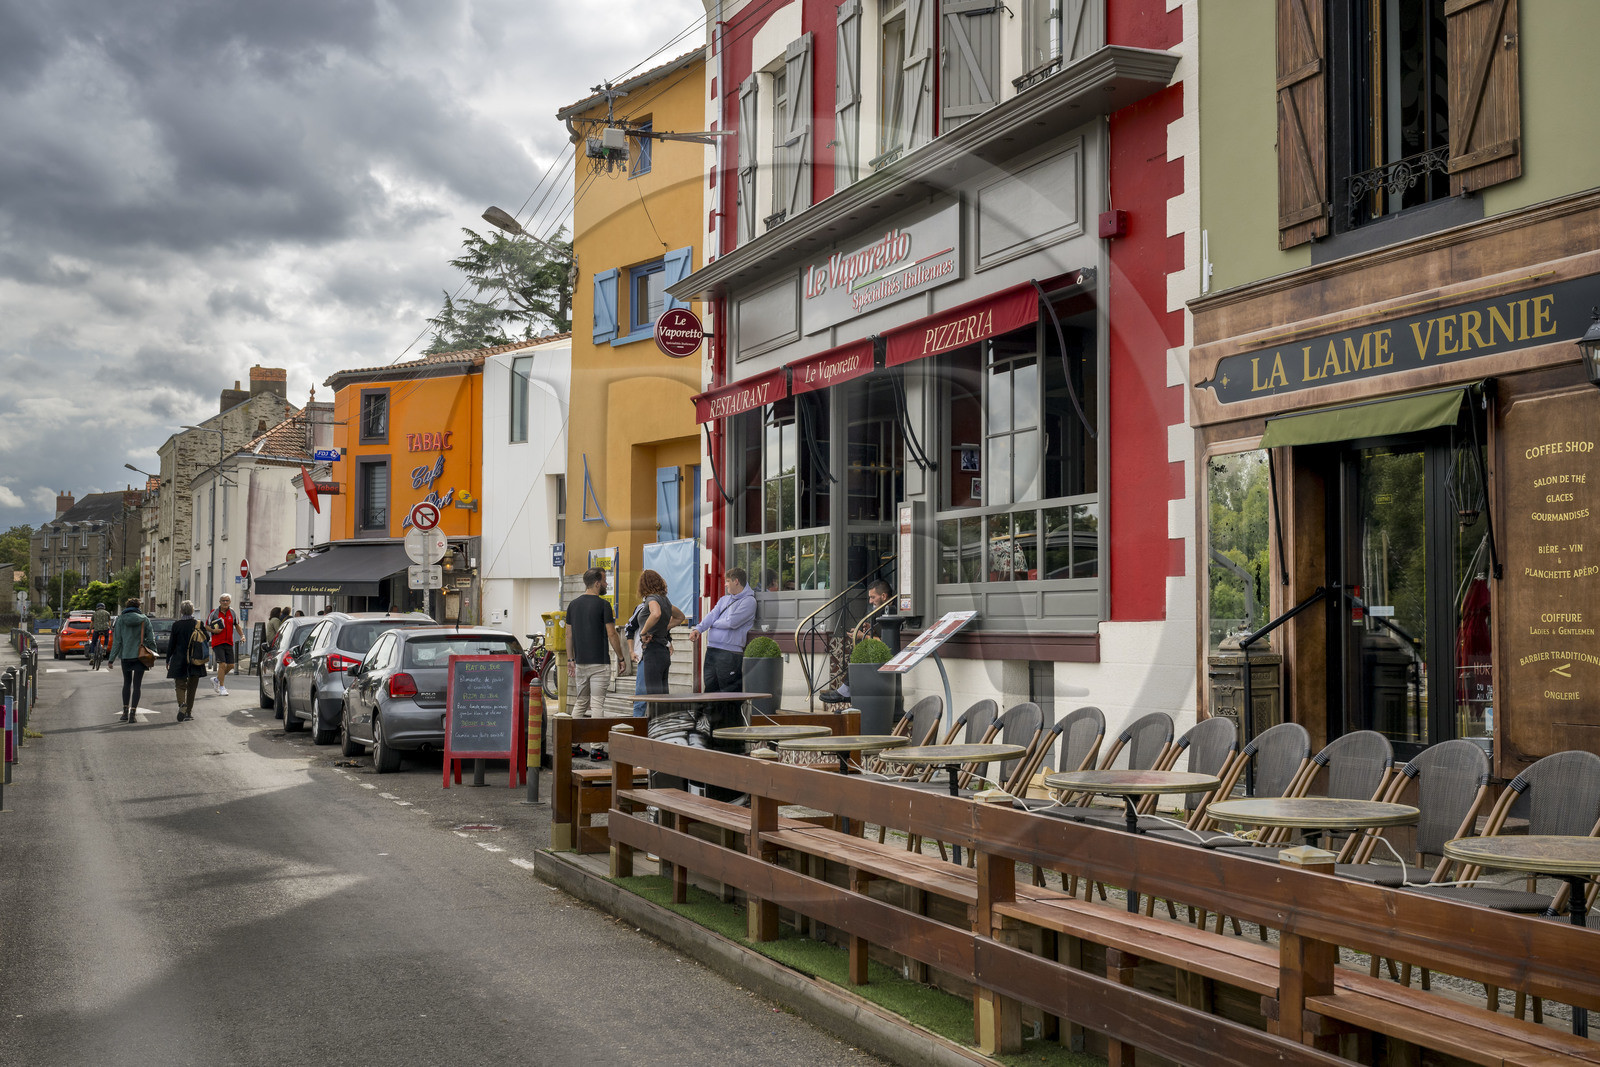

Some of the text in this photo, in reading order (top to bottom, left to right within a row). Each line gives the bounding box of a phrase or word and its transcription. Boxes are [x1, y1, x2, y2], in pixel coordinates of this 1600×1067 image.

[805, 228, 912, 300] Le Vaporetto
[852, 259, 954, 313] Spécialités Italiennes
[674, 315, 687, 325] Le
[659, 326, 702, 340] Vaporetto
[922, 308, 993, 355] PIZZERIA
[1251, 293, 1557, 392] LA LAME VERNIE
[804, 354, 859, 384] Le Vaporetto
[709, 382, 770, 419] RESTAURANT
[406, 431, 453, 452] TABAC
[1525, 441, 1594, 460] COFFEE SHOP
[411, 455, 446, 489] Café
[316, 484, 339, 492] Tabac
[1533, 473, 1586, 488] SALON DE THÉ
[1546, 493, 1574, 503] GLACES
[1531, 508, 1590, 522] GOURMANDISES
[1538, 543, 1559, 554] BIÈRE
[1569, 544, 1583, 553] VIN
[1525, 565, 1599, 579] PLANCHETTE APÉRO
[1541, 613, 1582, 623] COIFFURE
[1520, 651, 1550, 667] BARBIER
[1544, 690, 1580, 700] ONGLERIE
